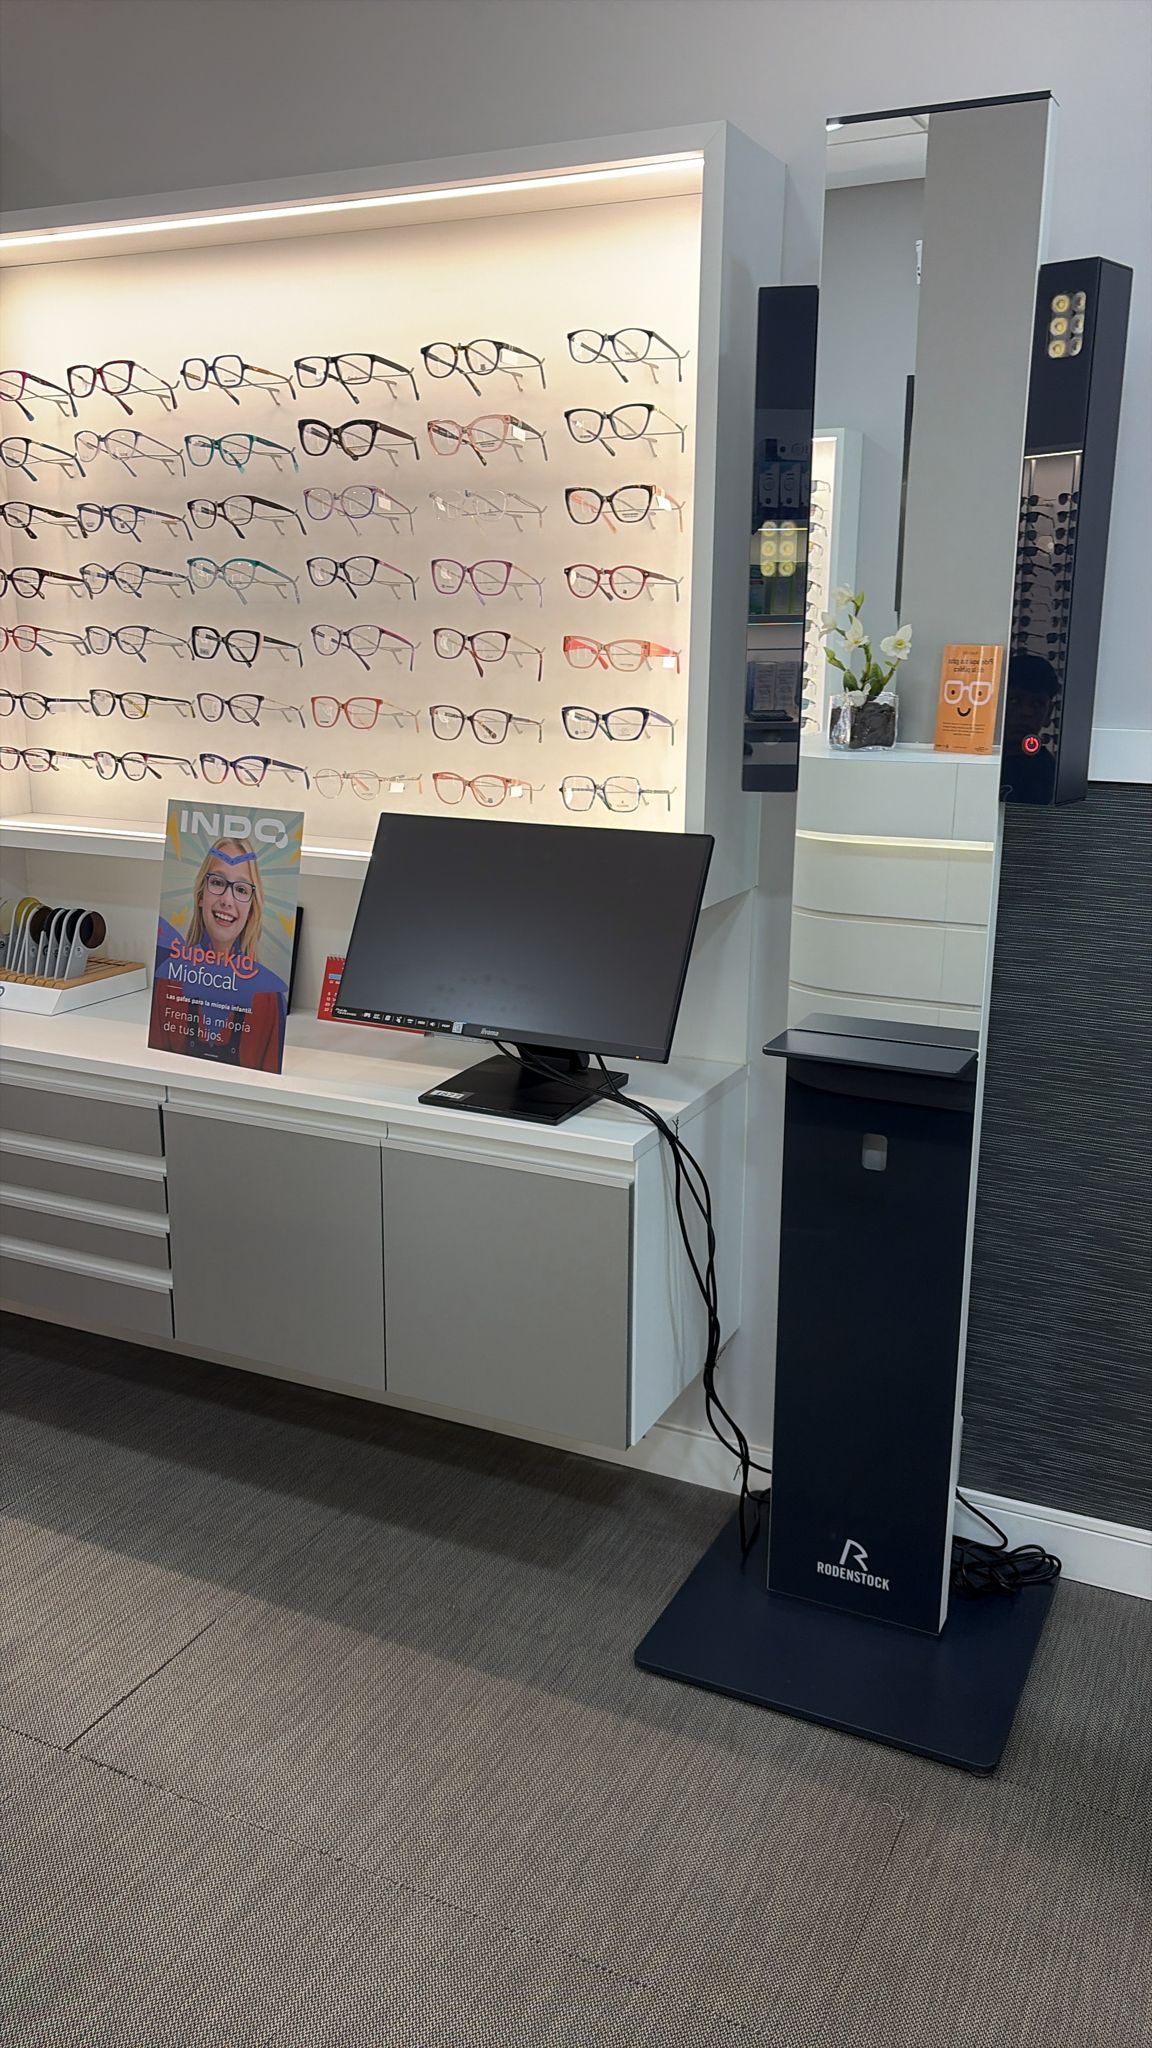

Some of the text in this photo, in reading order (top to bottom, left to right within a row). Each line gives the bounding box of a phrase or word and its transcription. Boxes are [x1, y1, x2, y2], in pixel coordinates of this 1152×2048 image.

[180, 810, 288, 848] INDO
[169, 938, 259, 979] Superkid
[168, 962, 238, 991] Miofocal
[176, 995, 191, 1003] gafas
[191, 998, 204, 1006] para
[165, 1007, 200, 1023] Frenan
[202, 1016, 212, 1026] la
[163, 1021, 224, 1042] de tus hijos.
[816, 1561, 890, 1591] RODENSTOCK
